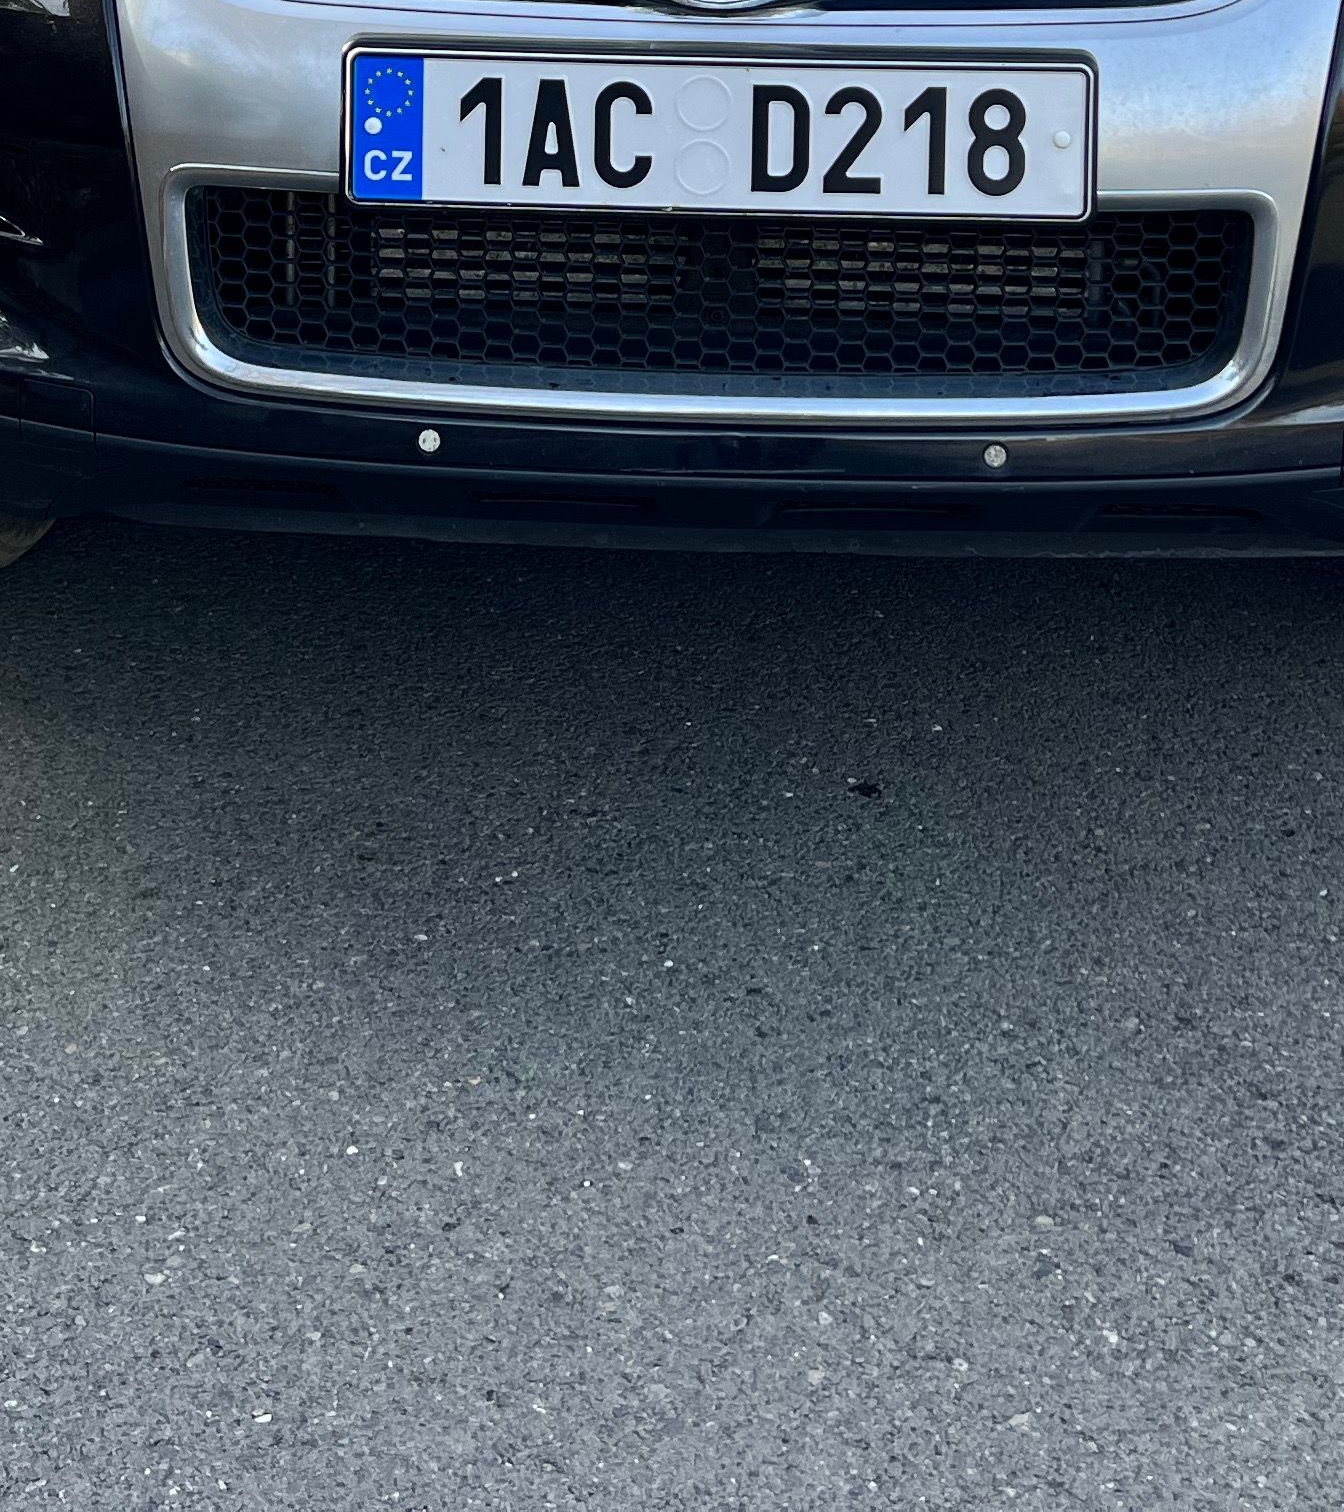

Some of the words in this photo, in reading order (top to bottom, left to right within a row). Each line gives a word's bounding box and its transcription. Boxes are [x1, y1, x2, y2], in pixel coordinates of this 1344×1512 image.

[363, 149, 414, 182] CZ
[459, 75, 654, 190] 1AC
[750, 84, 1028, 197] D218
